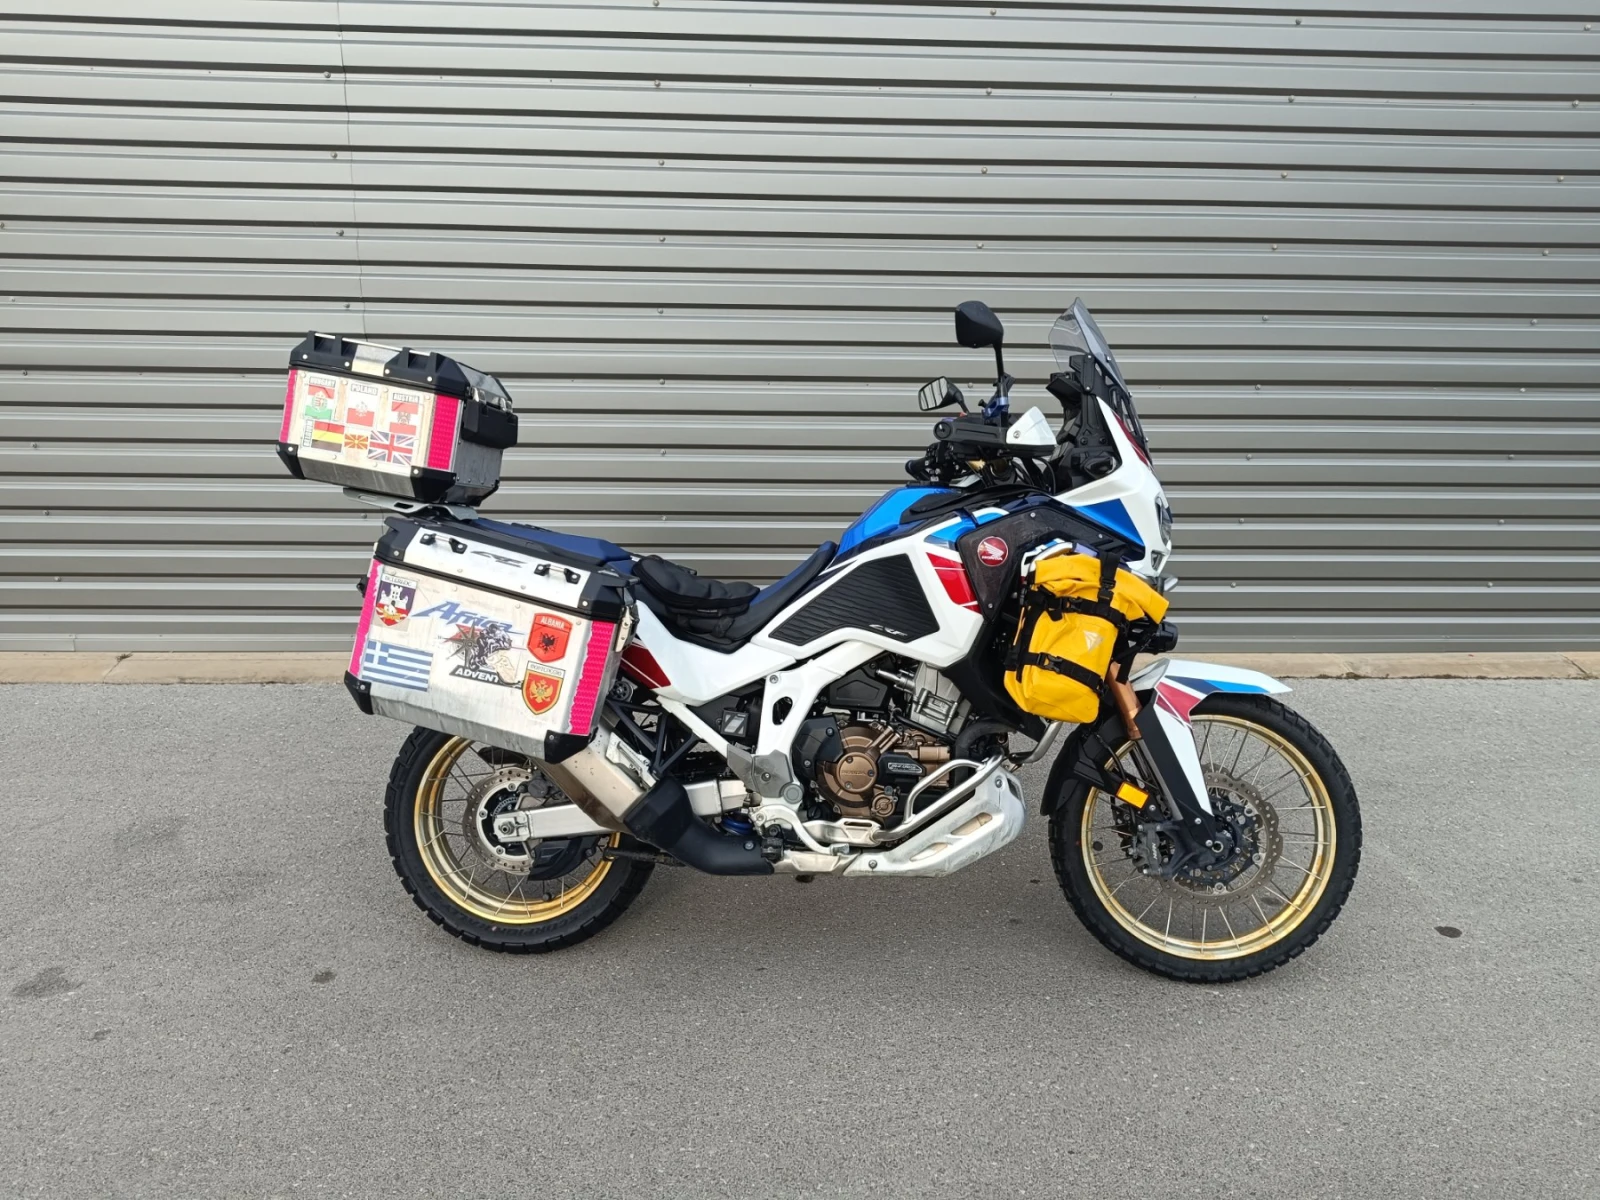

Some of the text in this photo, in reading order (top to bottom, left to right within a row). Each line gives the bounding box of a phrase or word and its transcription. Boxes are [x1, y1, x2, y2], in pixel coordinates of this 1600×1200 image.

[351, 384, 378, 396] POLAND
[393, 393, 419, 404] AUSTRIA
[411, 601, 523, 634] Africa
[541, 615, 566, 629] ALBANIA
